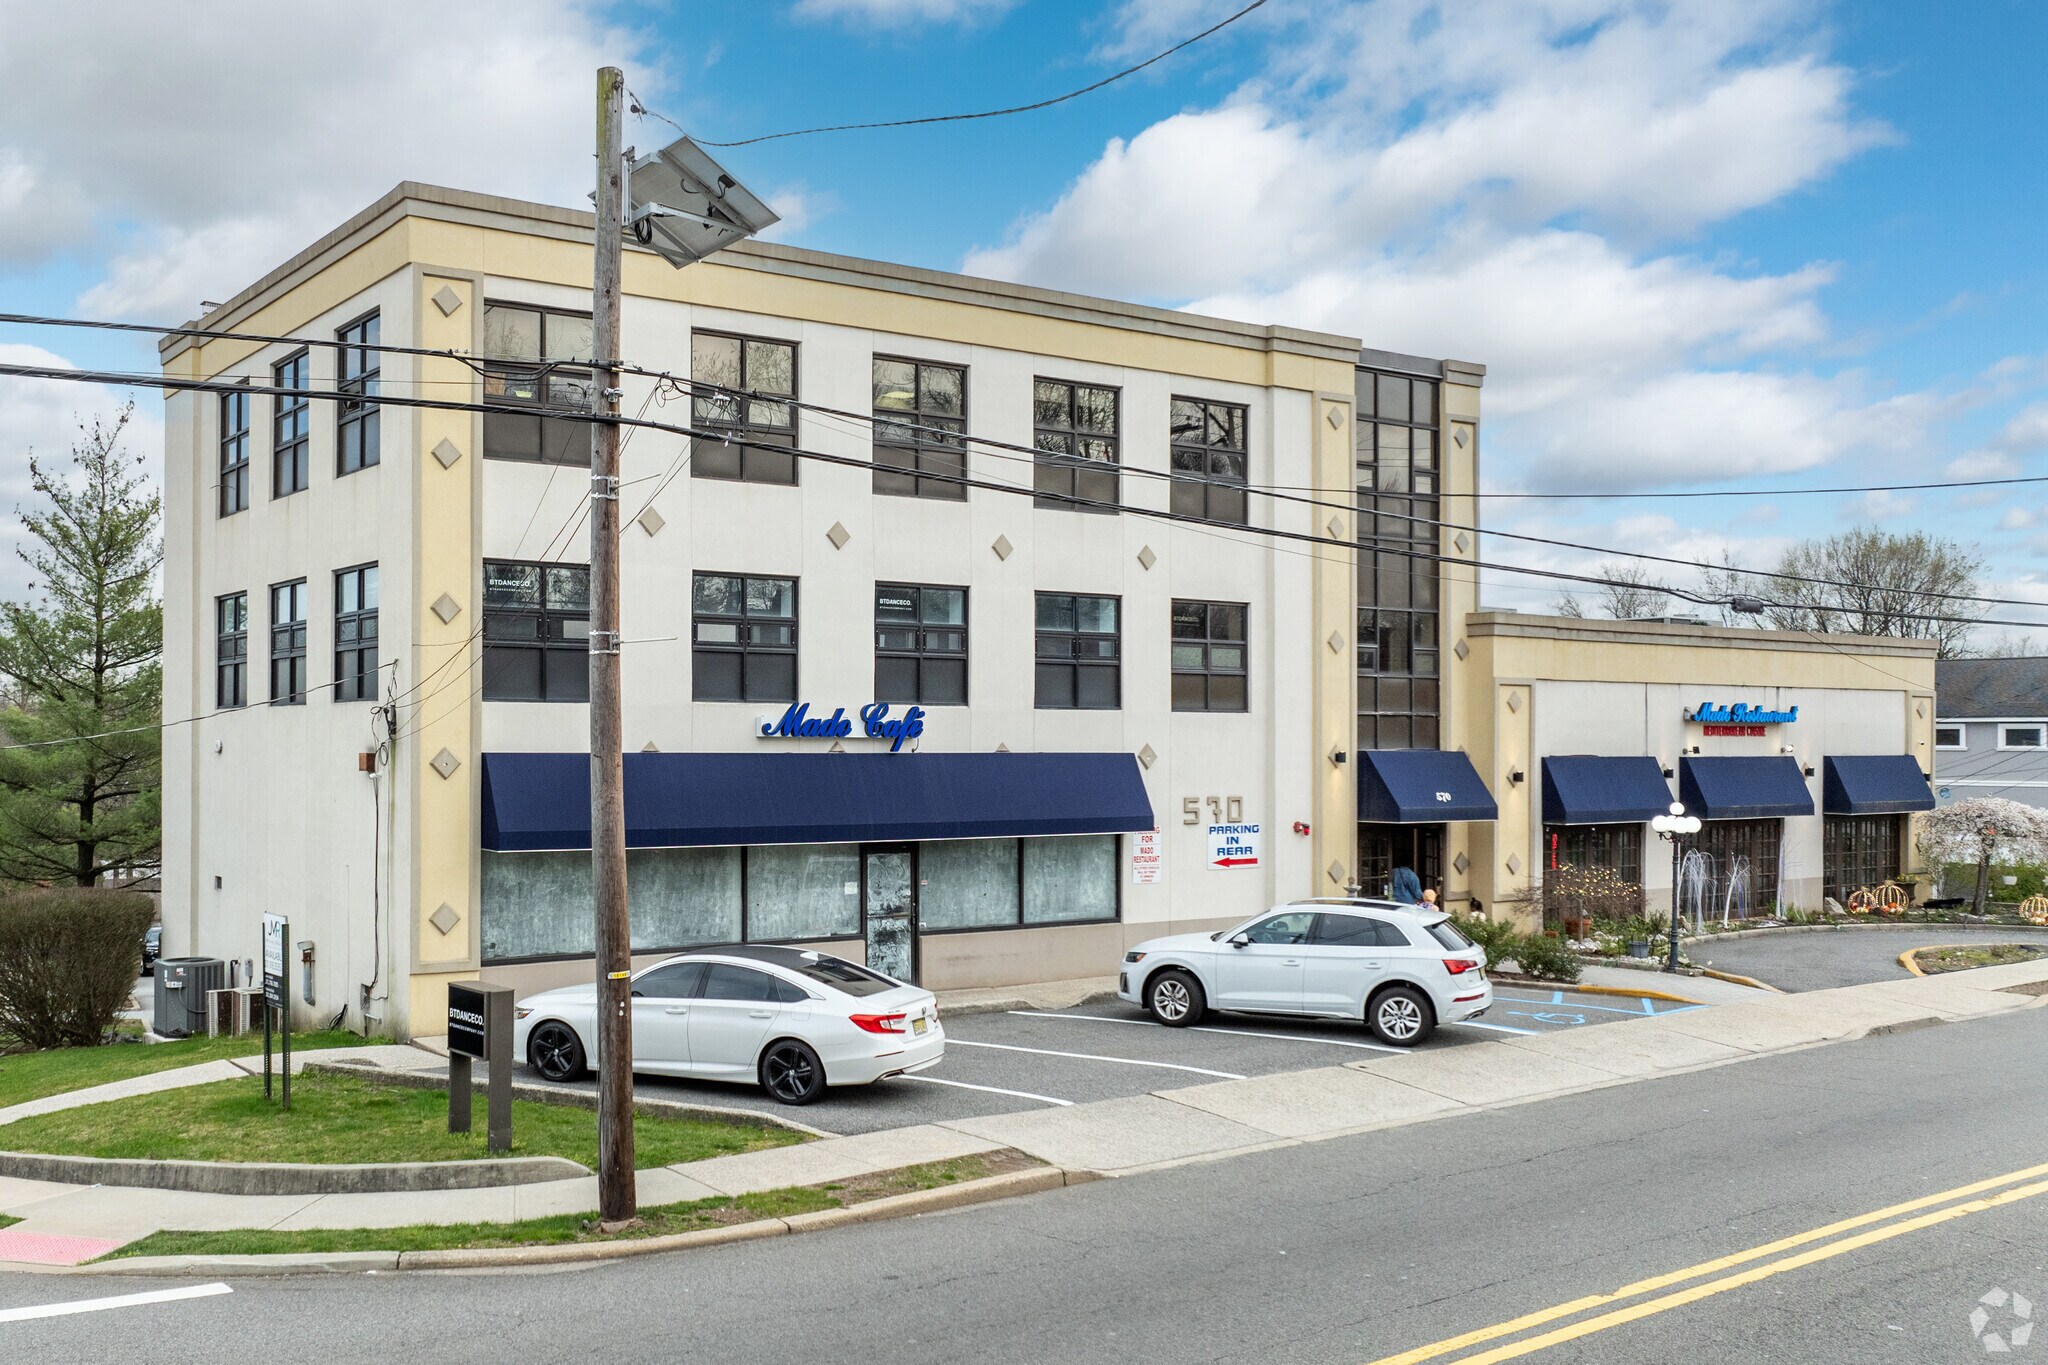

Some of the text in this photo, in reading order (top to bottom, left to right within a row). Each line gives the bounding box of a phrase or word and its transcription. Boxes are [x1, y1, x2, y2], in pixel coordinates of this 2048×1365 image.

[1693, 702, 1798, 723] Mado Restaurant
[762, 702, 926, 752] Mado Café
[1436, 791, 1452, 803] 570
[1183, 796, 1243, 825] 570
[1209, 825, 1260, 835] PARKING
[1141, 835, 1153, 843] FOR
[1226, 836, 1239, 845] IN
[1217, 846, 1253, 856] REAR
[449, 1007, 485, 1026] BTDANCECO.
